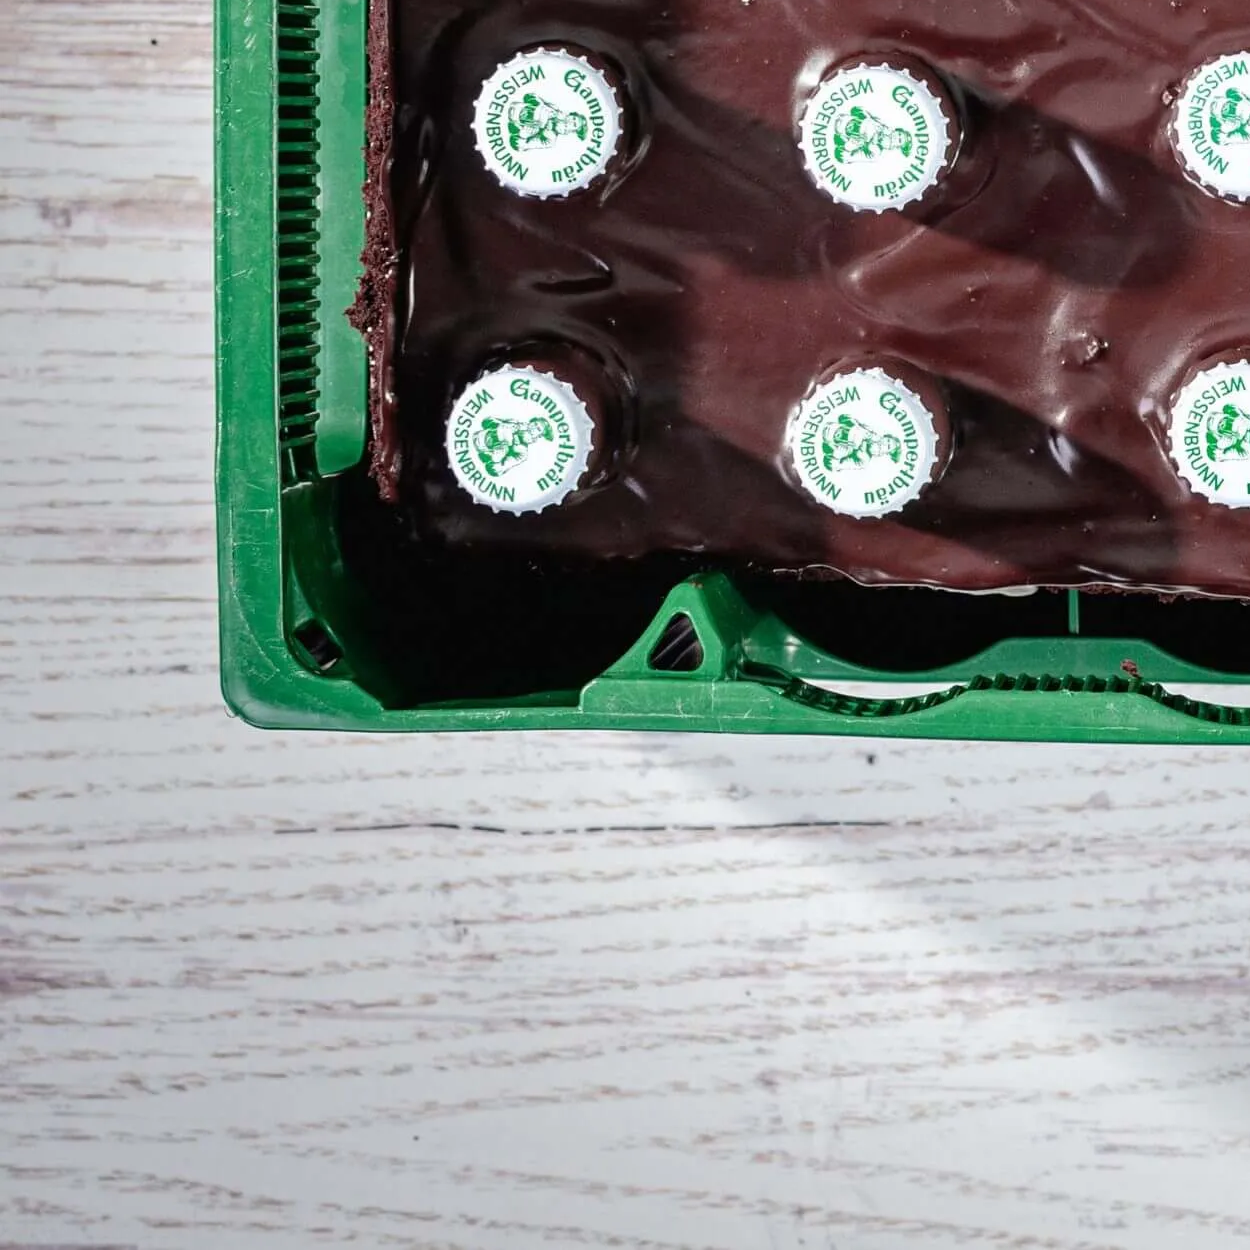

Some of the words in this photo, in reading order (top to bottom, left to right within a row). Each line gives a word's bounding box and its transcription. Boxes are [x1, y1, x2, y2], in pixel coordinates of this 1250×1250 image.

[486, 65, 545, 181] WEISSENBRUNN
[552, 69, 605, 183] Gampertbräu
[812, 79, 872, 191] WEISSENBRUNN
[874, 85, 929, 197] Gampertbräu
[1188, 61, 1248, 174] WEISSENBRUNN
[454, 389, 515, 502] WEISSENBRUNN
[510, 380, 575, 491] Gampertbräu
[800, 386, 859, 501] WEISSENBRUNN
[864, 392, 918, 504] Gampertbräu
[1184, 376, 1245, 491] WEISSENBRUNN
